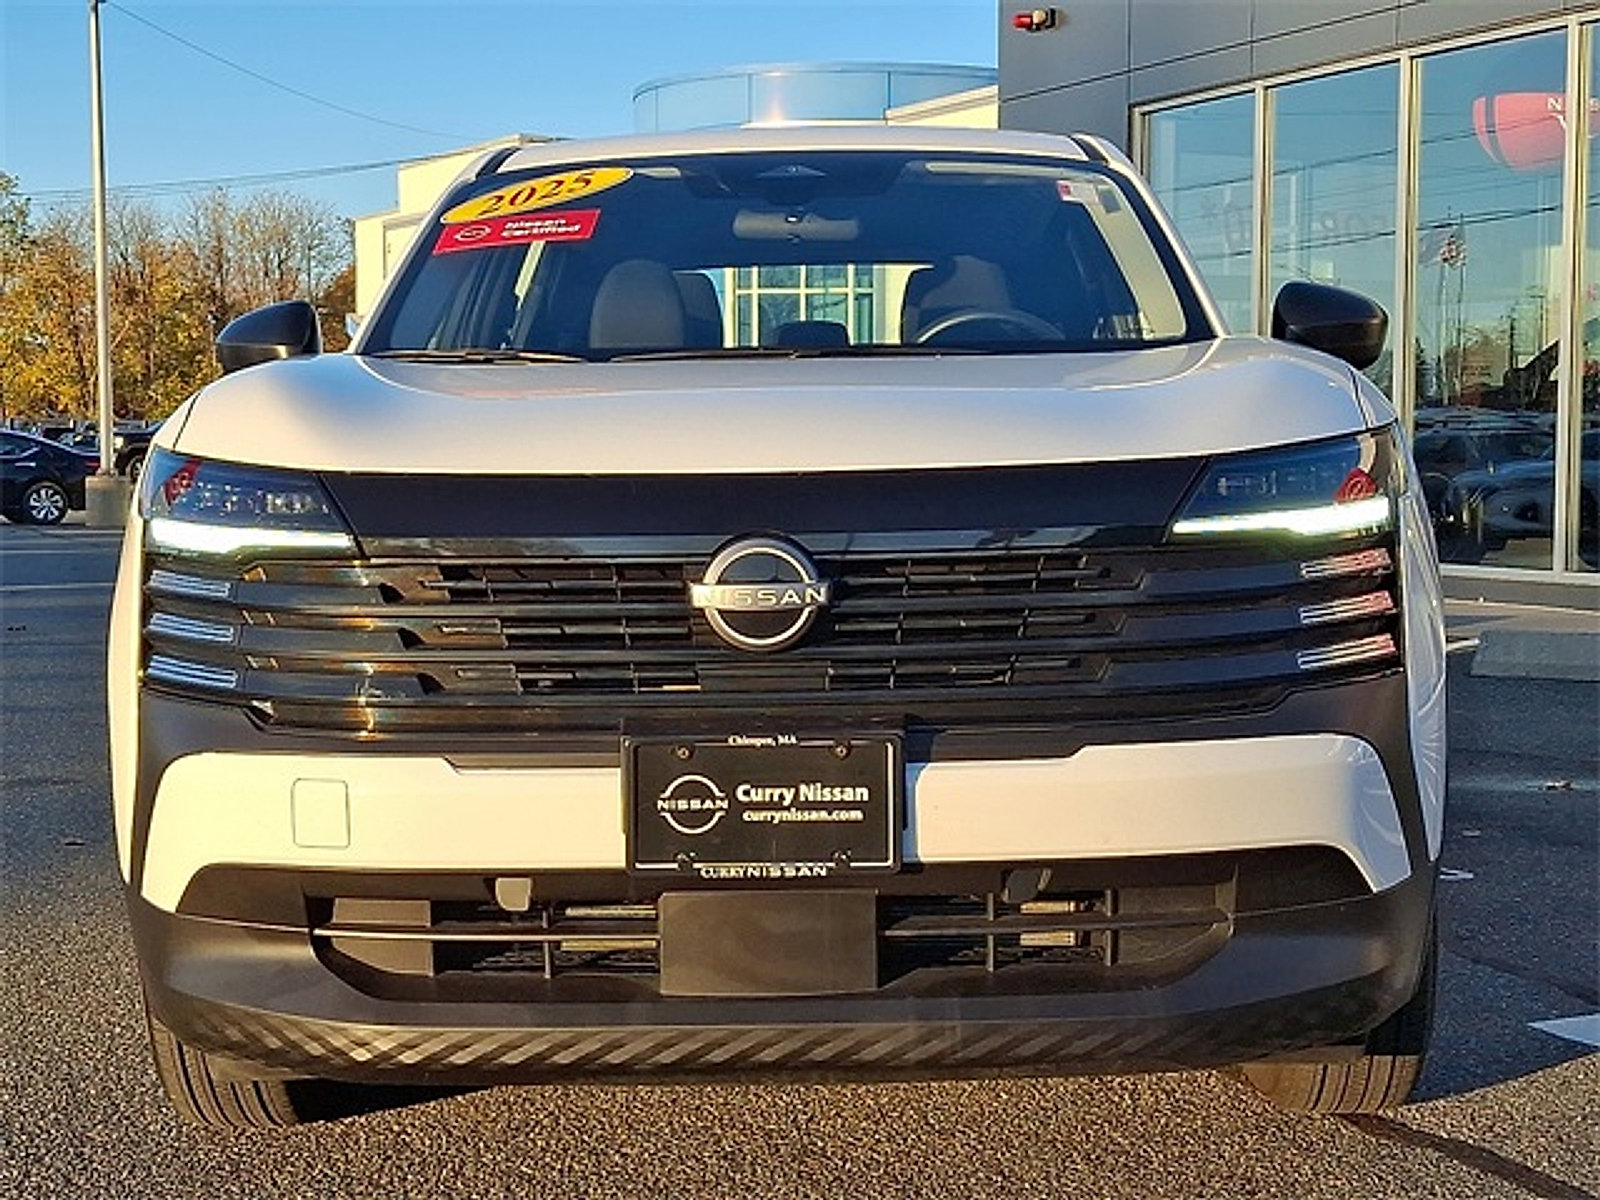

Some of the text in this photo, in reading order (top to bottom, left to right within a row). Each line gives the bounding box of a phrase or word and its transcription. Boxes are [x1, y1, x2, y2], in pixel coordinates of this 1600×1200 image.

[479, 171, 597, 217] 2025
[699, 586, 826, 604] NISSAN
[736, 782, 869, 806] Curry Nissan
[657, 799, 729, 811] NISSAN
[742, 808, 863, 823] currynissan.com
